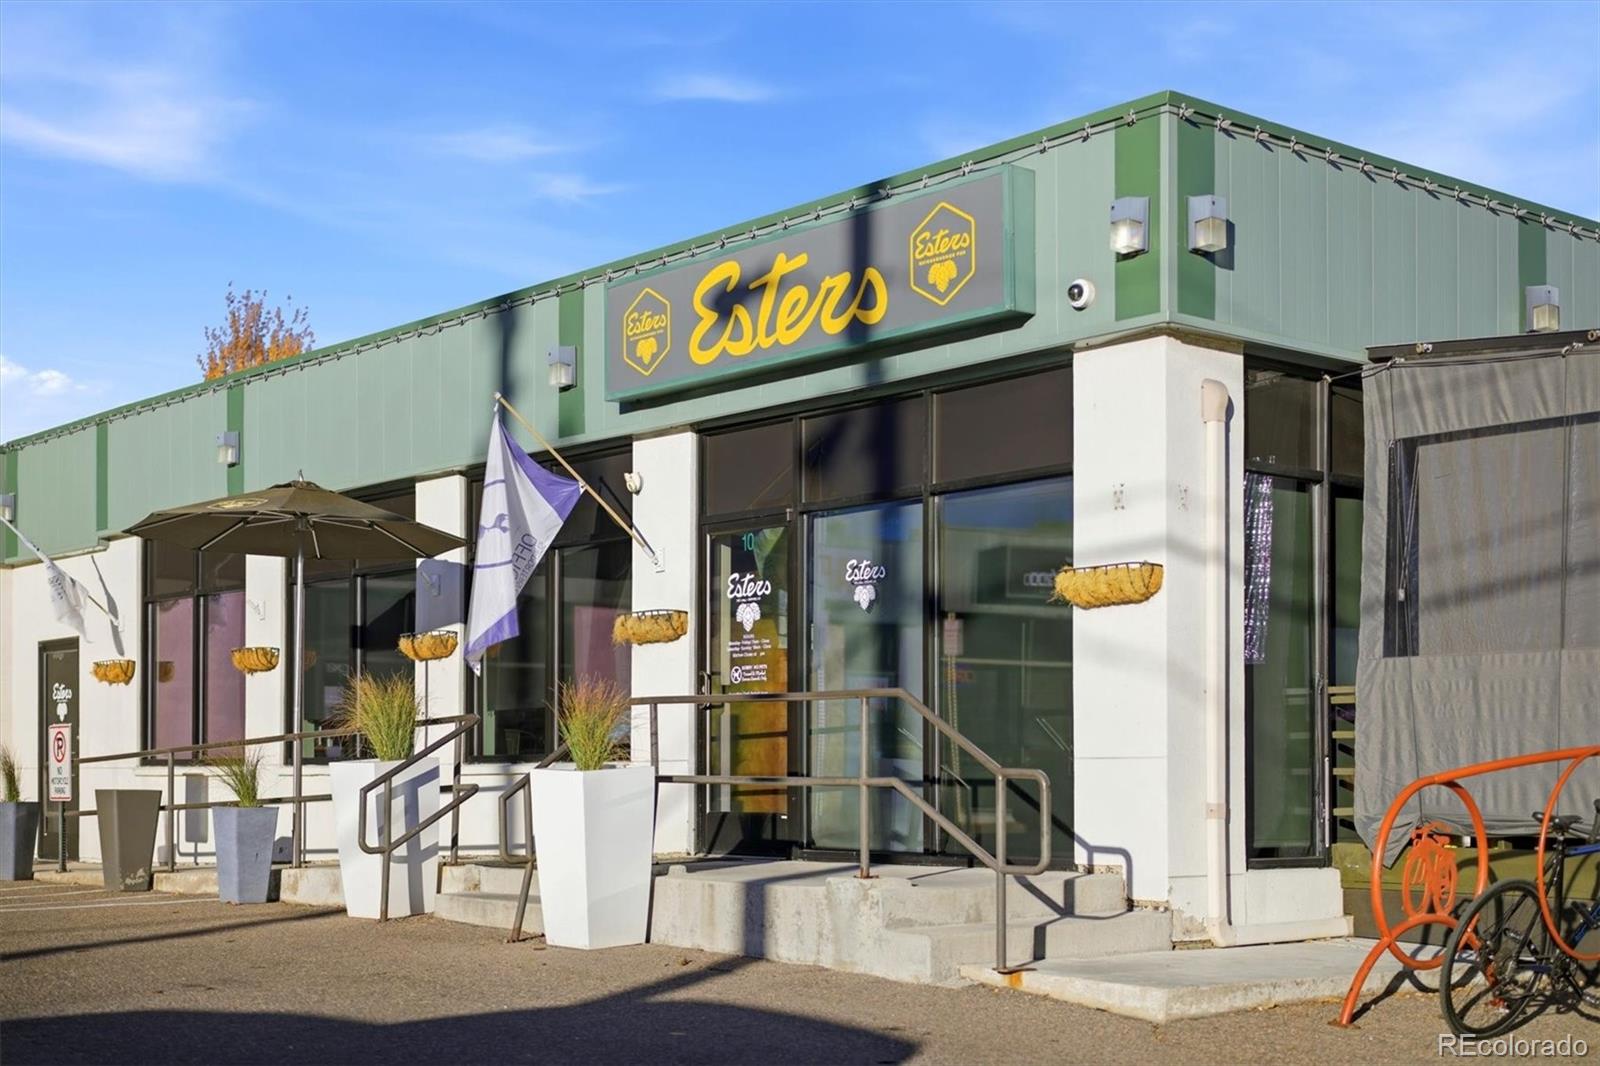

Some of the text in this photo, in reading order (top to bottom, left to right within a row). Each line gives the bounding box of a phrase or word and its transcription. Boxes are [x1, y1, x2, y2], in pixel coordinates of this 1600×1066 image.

[914, 229, 970, 259] Esters
[688, 252, 888, 366] Esters
[627, 310, 667, 336] Esters
[845, 559, 886, 581] Esters
[727, 572, 772, 599] Esters
[52, 682, 72, 700] Esters
